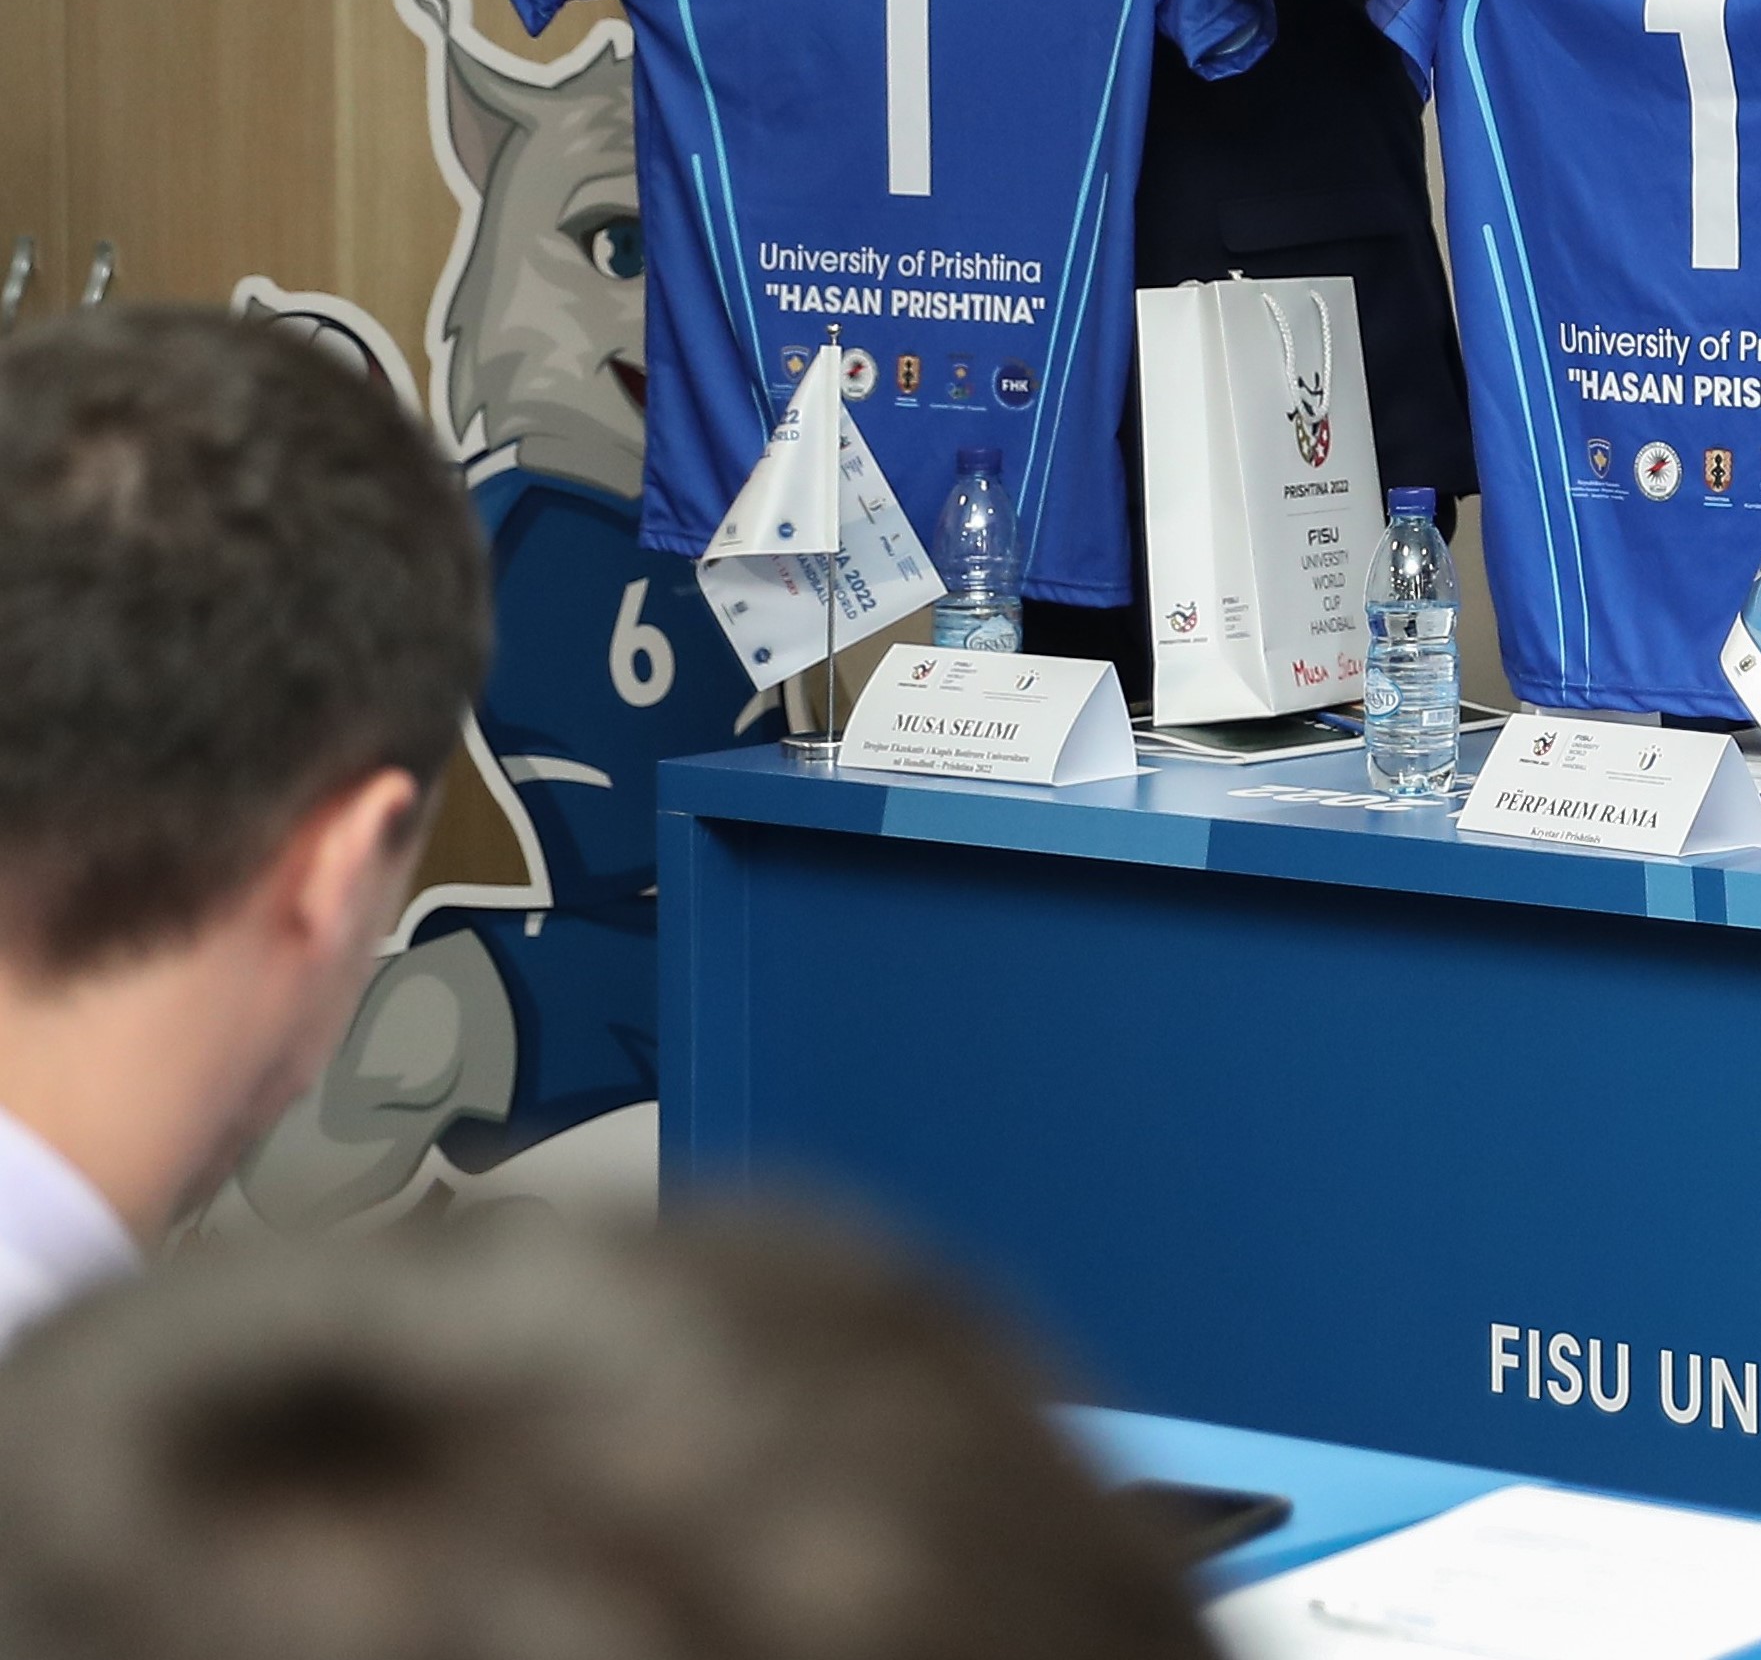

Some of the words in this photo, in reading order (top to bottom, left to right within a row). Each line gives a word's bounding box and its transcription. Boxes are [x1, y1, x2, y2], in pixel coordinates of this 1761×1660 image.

[759, 242, 889, 281] University
[899, 250, 926, 277] of
[931, 250, 1041, 283] Prishtina
[766, 283, 882, 316] "HASAN
[890, 291, 1047, 325] PRISHTINA"
[1560, 322, 1690, 366] University
[1699, 330, 1731, 361] of
[1001, 377, 1030, 393] FHK
[1567, 368, 1685, 406] "HASAN
[1284, 482, 1330, 500] PRISHTINA
[1331, 480, 1349, 494] 2022
[1308, 527, 1339, 546] FISU
[1301, 550, 1349, 570] UNIVERSITY
[844, 569, 878, 613] 2022
[1312, 573, 1346, 590] WORLD
[1323, 595, 1342, 612] CUP
[609, 577, 675, 707] 6
[1310, 616, 1356, 636] HANDBALL
[892, 714, 945, 735] MUSA
[949, 719, 1021, 740] SELIMI
[1495, 789, 1599, 821] PËRPARIM
[1600, 804, 1660, 829] RAMA
[1489, 1321, 1632, 1415] FISU
